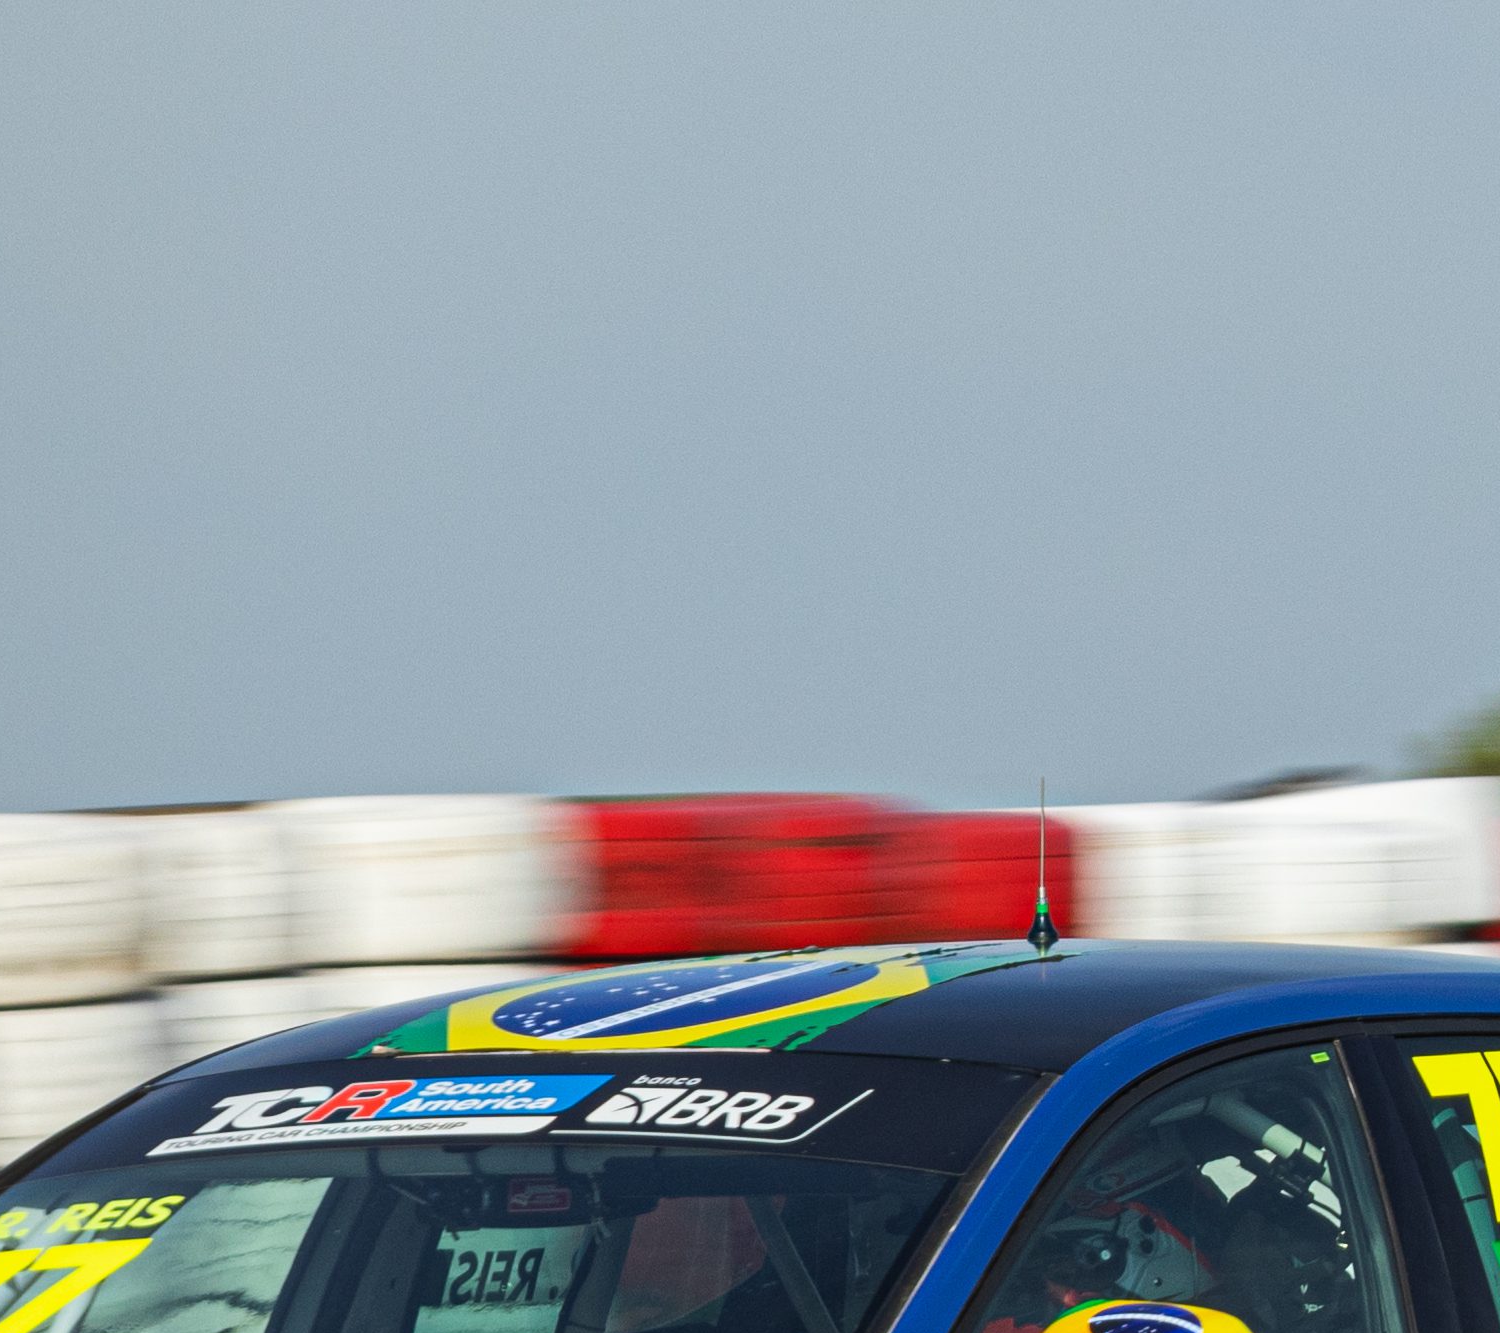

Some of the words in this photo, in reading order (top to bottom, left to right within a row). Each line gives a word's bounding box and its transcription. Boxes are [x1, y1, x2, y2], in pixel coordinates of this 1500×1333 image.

[417, 1078, 537, 1097] South
[631, 1074, 702, 1086] banco
[192, 1080, 415, 1135] TCR
[390, 1092, 557, 1114] America
[654, 1088, 815, 1131] BRB
[165, 1132, 252, 1150] TOURING
[257, 1129, 301, 1141] CAR
[302, 1120, 468, 1138] CHAMPIONSHIP
[46, 1195, 186, 1234] REIS
